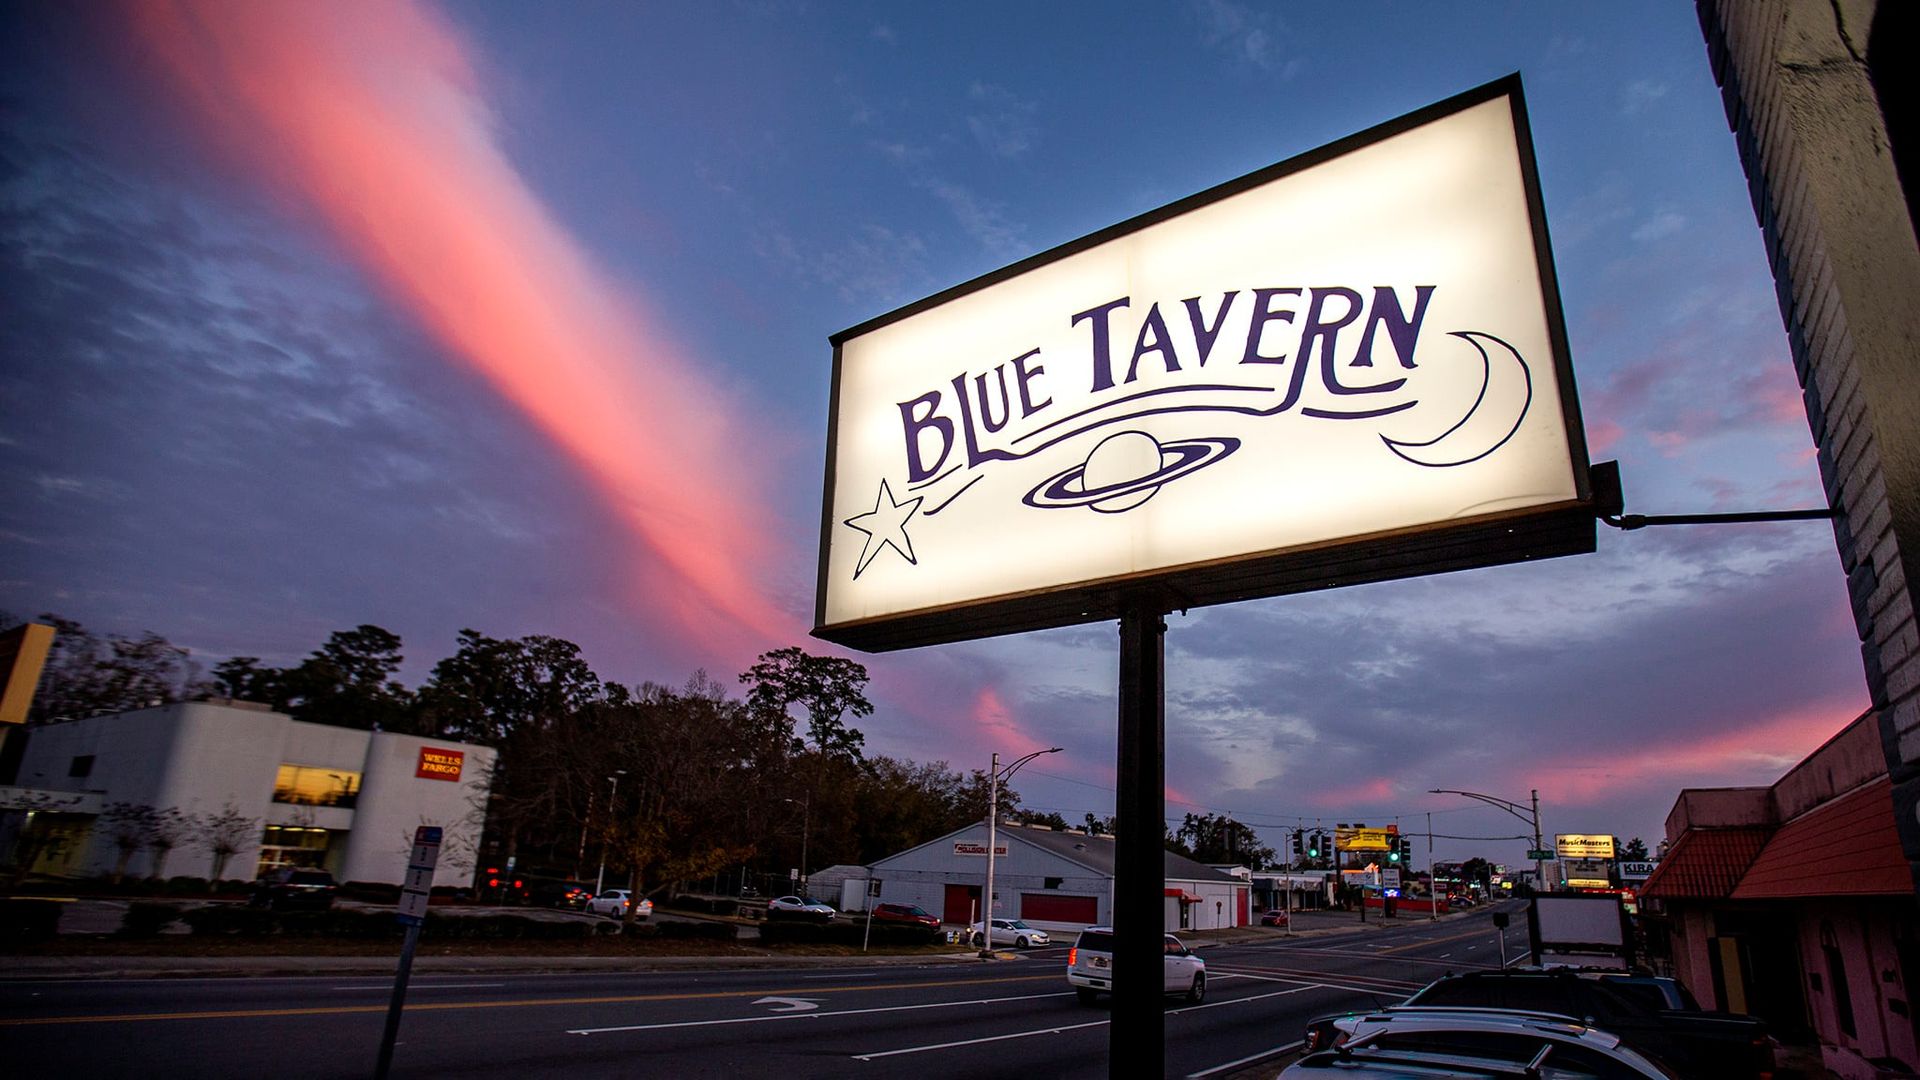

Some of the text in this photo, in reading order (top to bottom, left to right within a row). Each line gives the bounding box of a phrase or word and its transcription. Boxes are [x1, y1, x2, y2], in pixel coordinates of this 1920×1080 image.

[897, 285, 1437, 483] BLUE TAVERN
[424, 753, 462, 765] WELLS
[422, 762, 460, 775] FARGO
[1559, 838, 1610, 846] MusicMasters
[1624, 863, 1654, 872] KIRA
